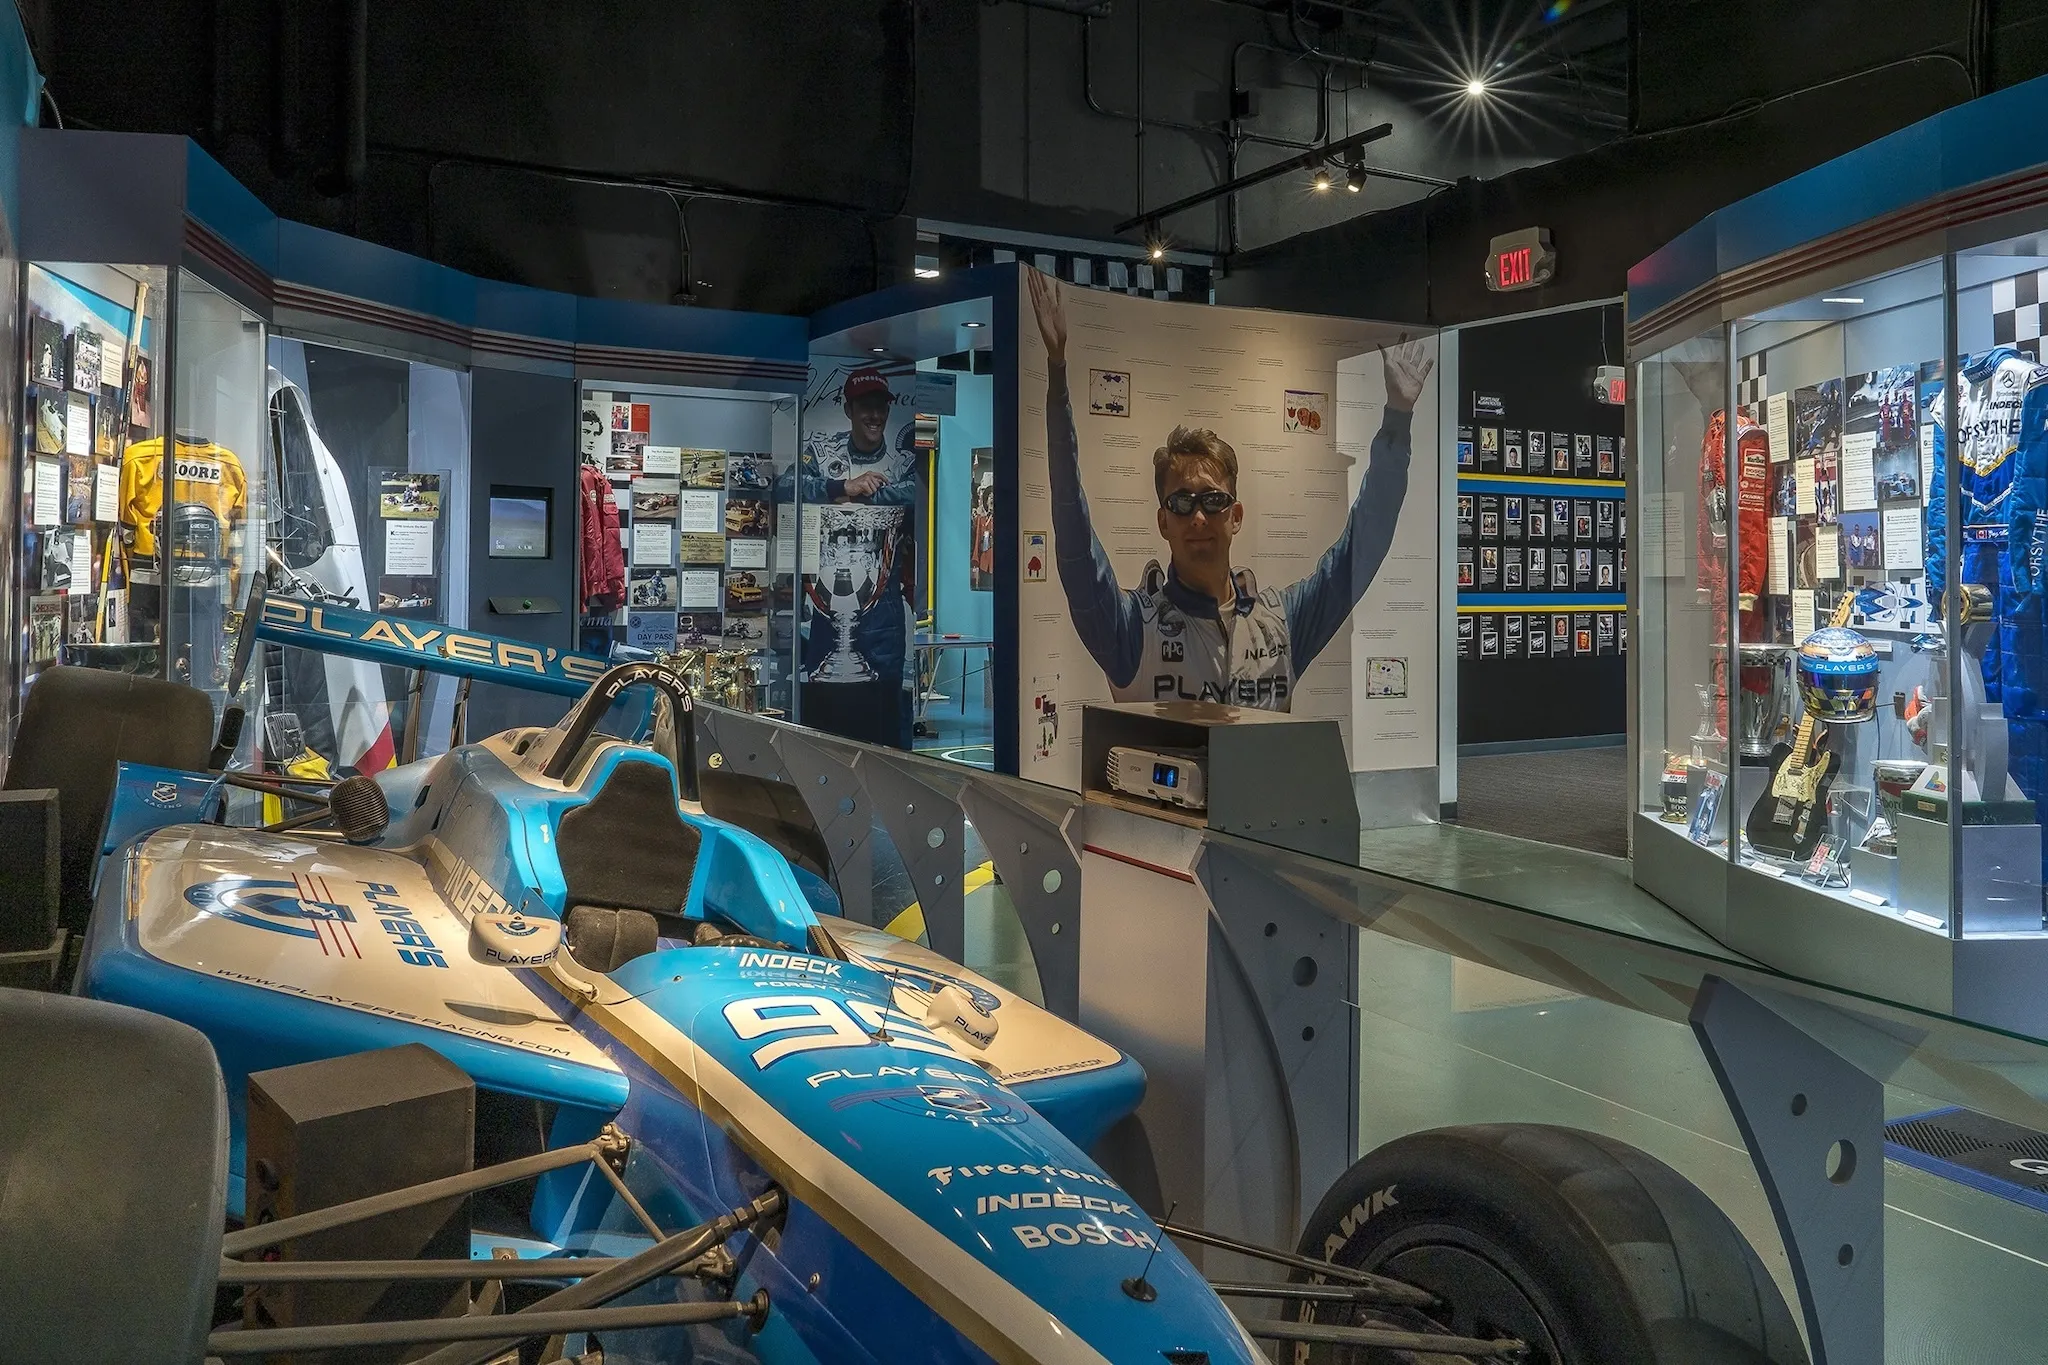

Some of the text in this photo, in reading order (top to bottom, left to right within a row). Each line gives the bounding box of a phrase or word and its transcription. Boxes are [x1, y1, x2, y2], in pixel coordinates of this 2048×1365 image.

[1500, 248, 1531, 286] EXIT
[1611, 380, 1625, 402] EXI
[161, 462, 219, 479] OORE
[263, 598, 608, 683] PLAYER'S
[1815, 662, 1873, 672] PLAYER'S
[606, 667, 693, 713] PLAYER'S
[354, 879, 449, 969] PLAYER'S
[739, 952, 843, 979] INDECK
[924, 1108, 1018, 1127] RACING
[927, 1164, 1123, 1192] Firestone
[976, 1192, 1141, 1220] INDECK
[1010, 1224, 1163, 1253] BOSCH
